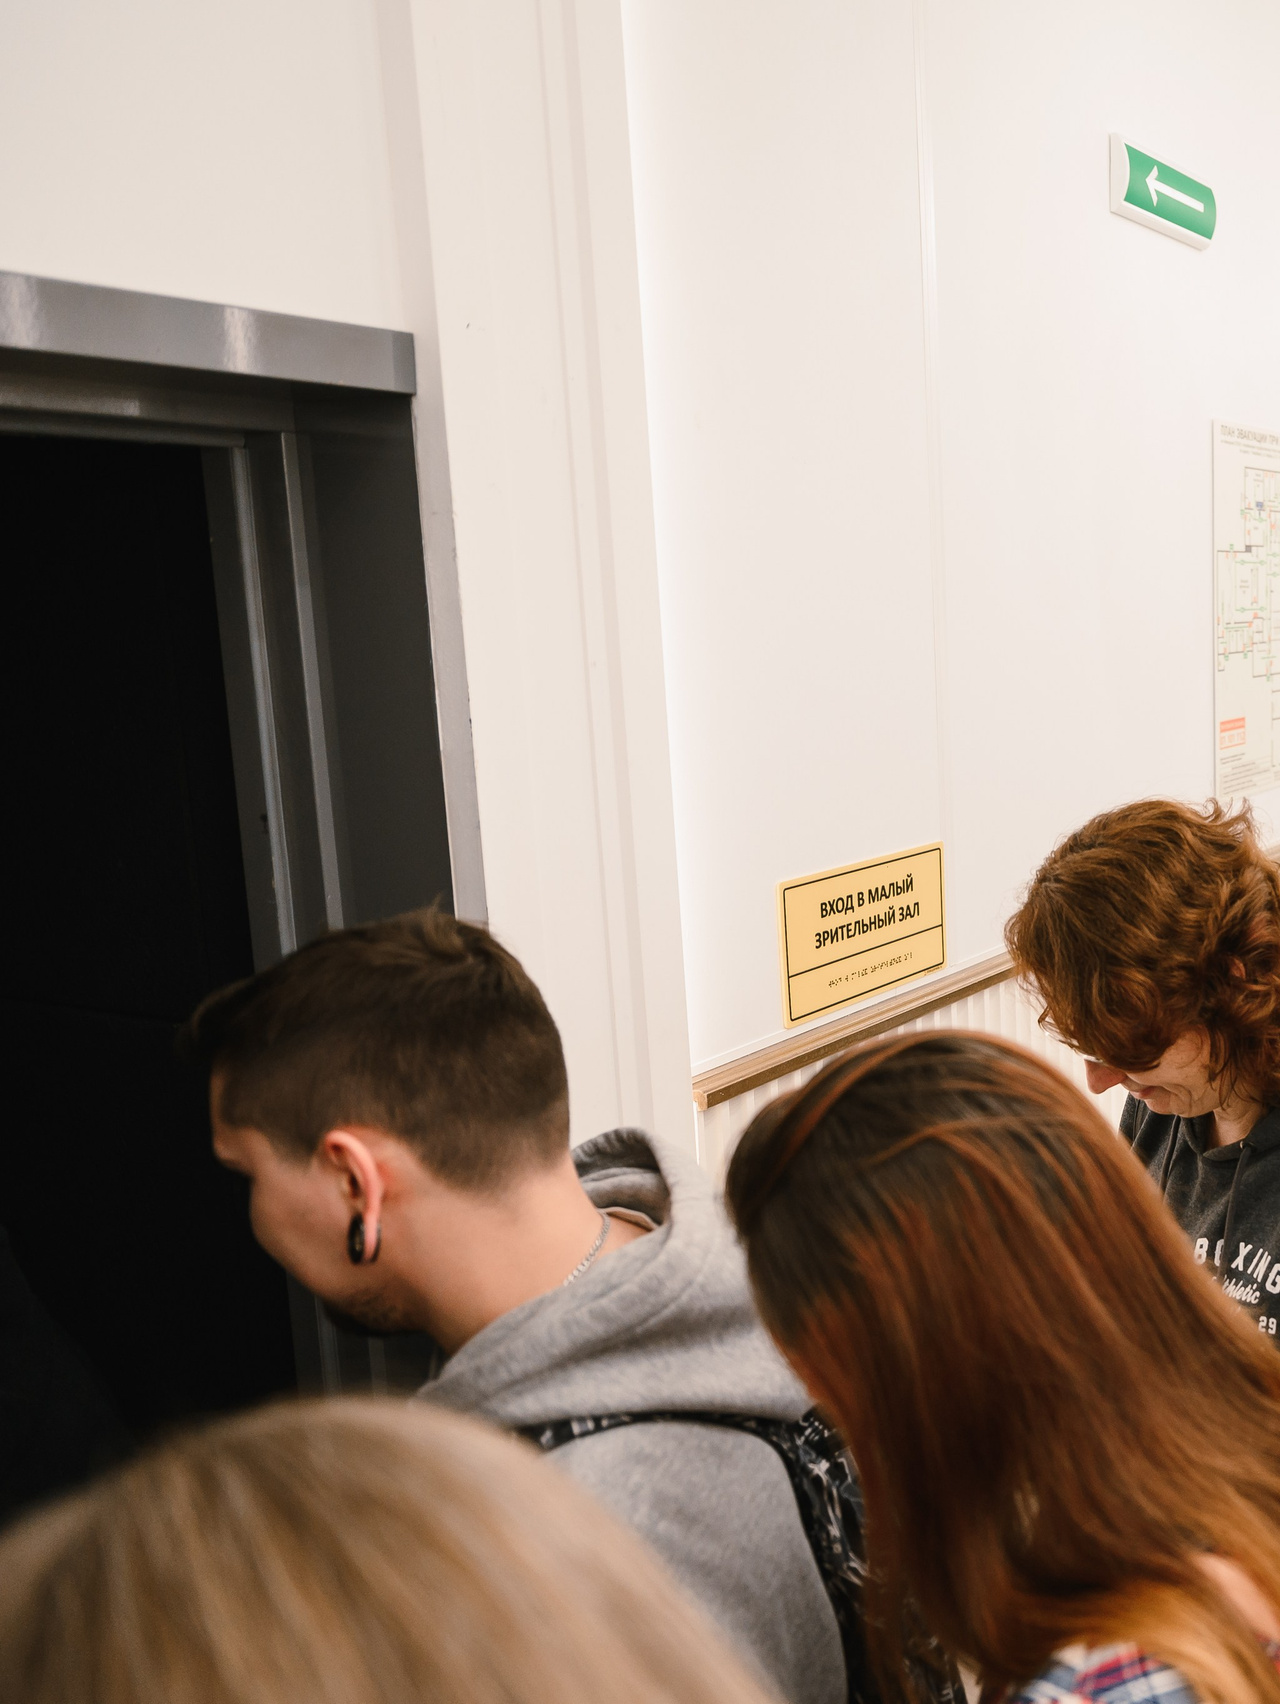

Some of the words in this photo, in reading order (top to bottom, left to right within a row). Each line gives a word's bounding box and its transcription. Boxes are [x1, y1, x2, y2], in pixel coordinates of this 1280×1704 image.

[820, 894, 855, 918] ВХОД
[857, 891, 865, 907] В
[868, 873, 914, 904] МАЛЫЙ
[815, 905, 896, 949] ЗРИТЕЛЬНЫЙ
[898, 902, 920, 922] ЗАЛ
[1213, 1274, 1260, 1304] thletic
[1258, 1315, 1277, 1334] 29
